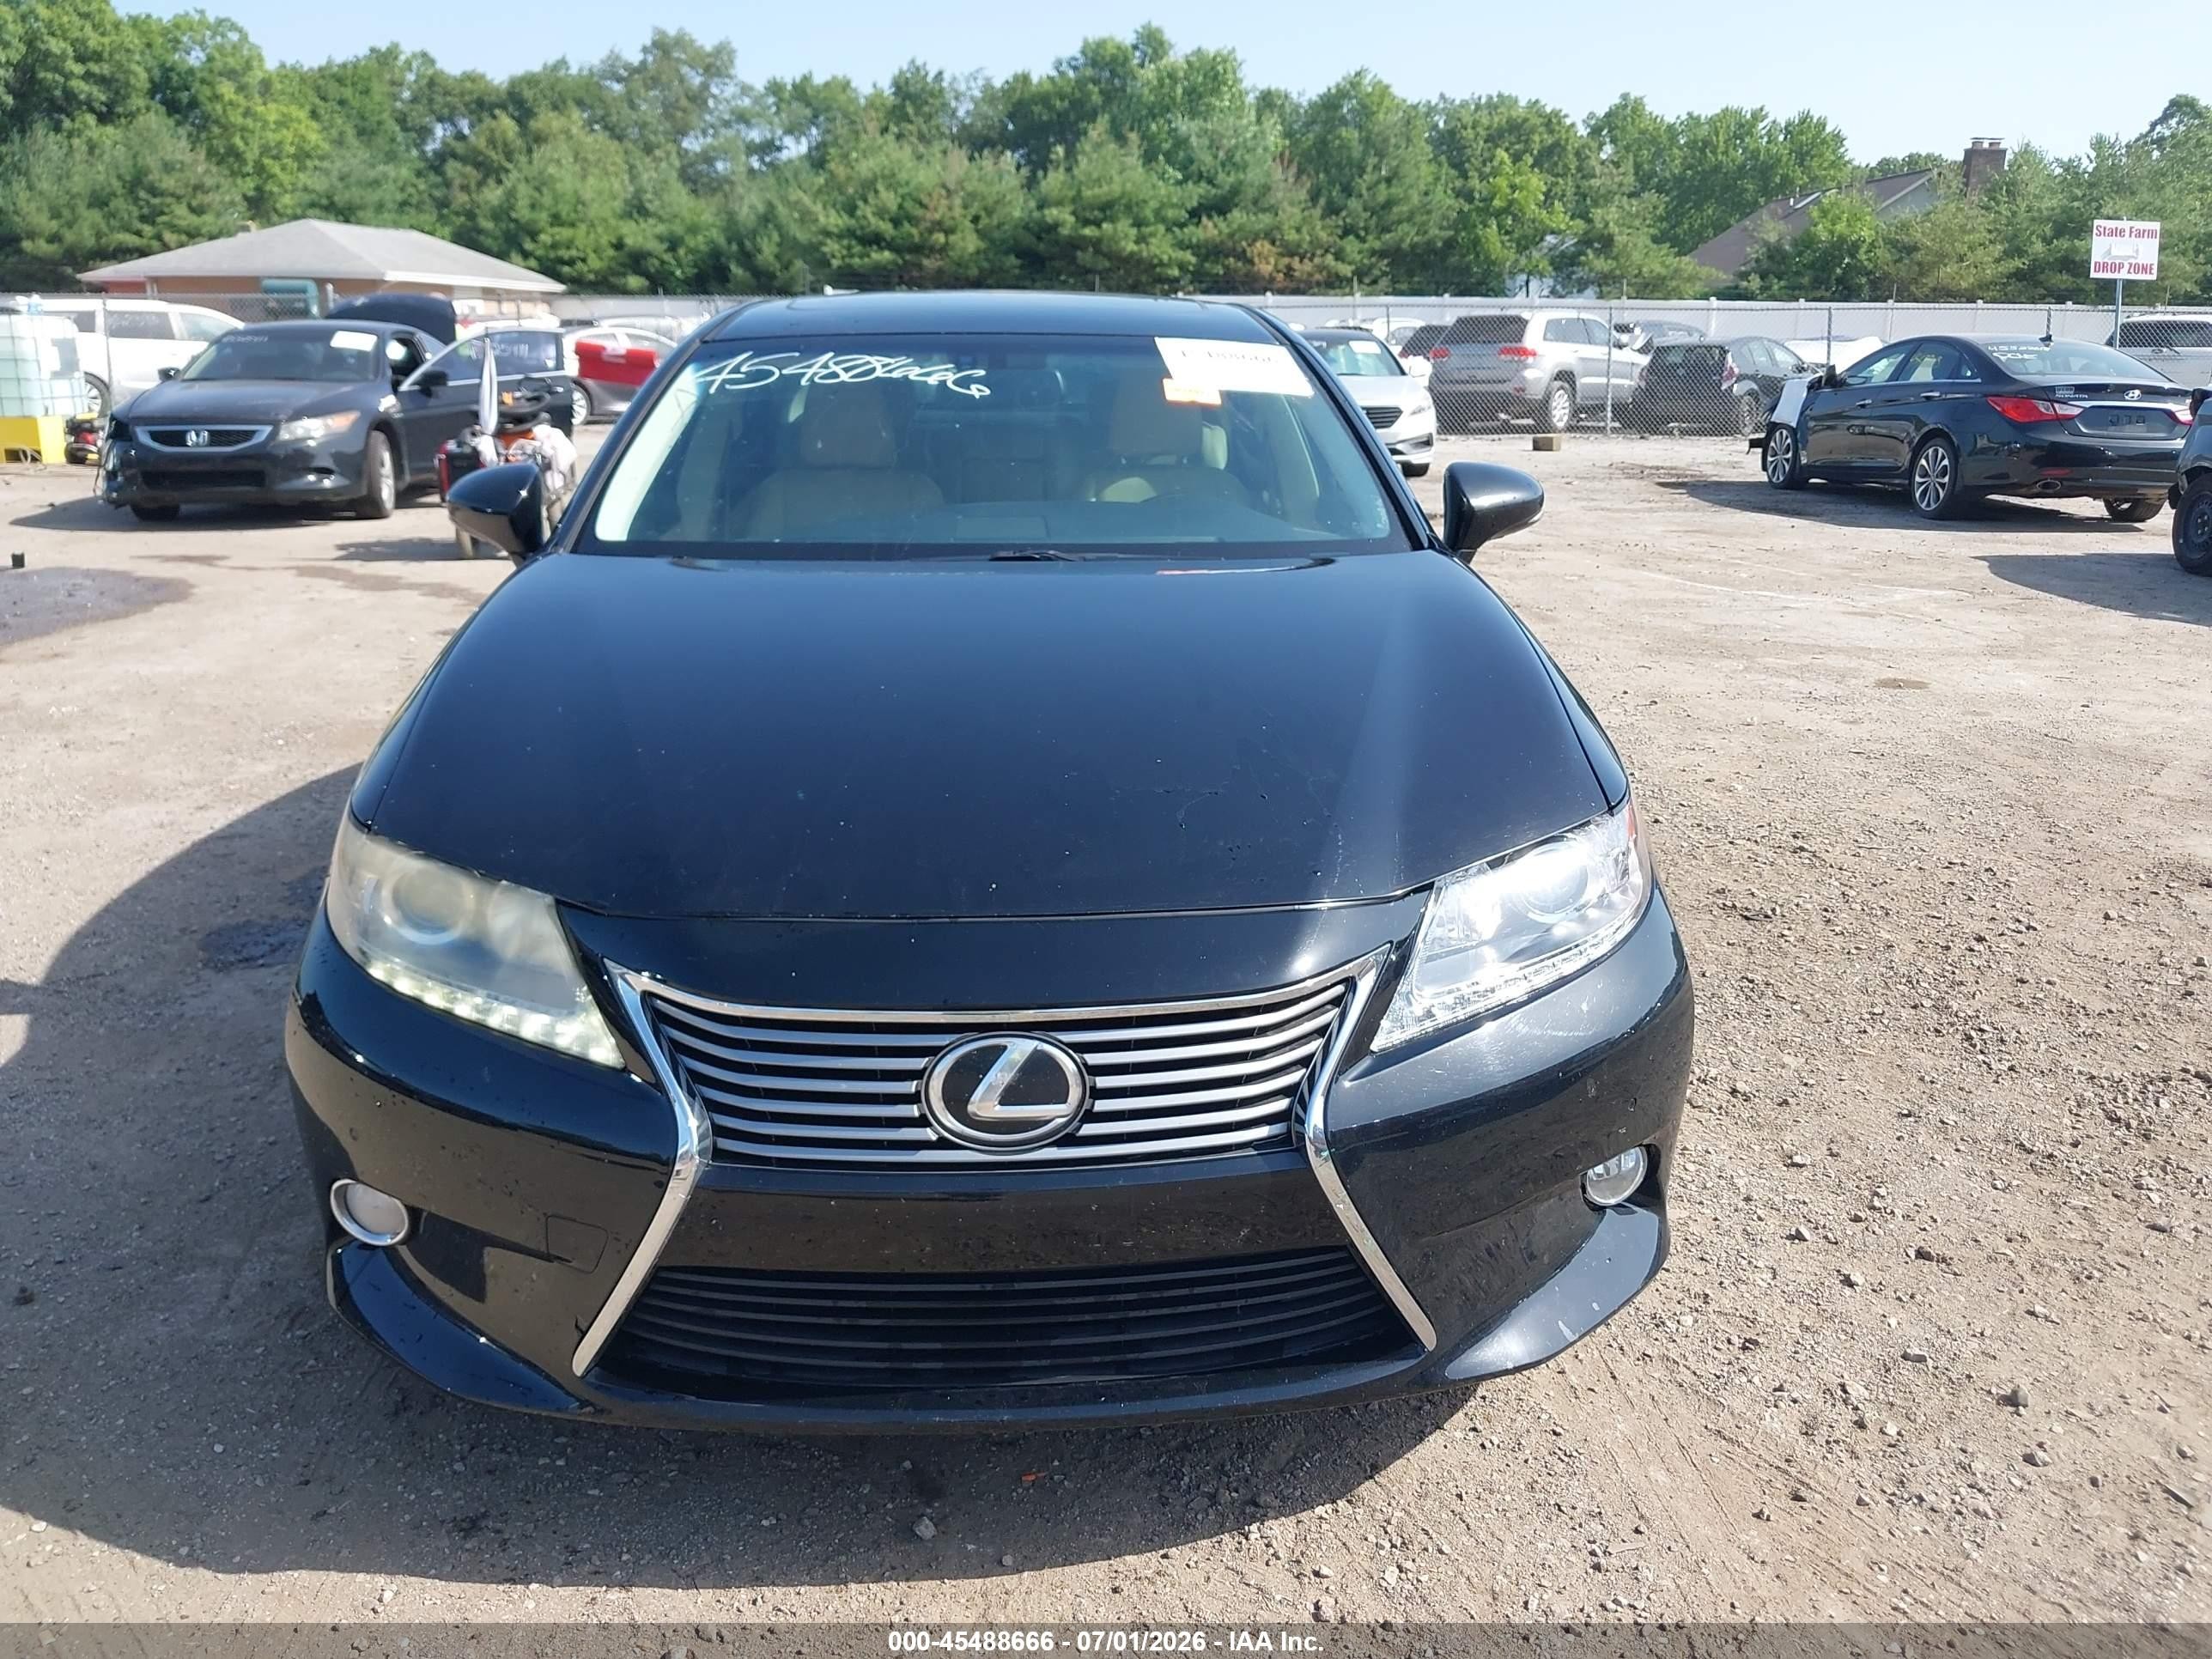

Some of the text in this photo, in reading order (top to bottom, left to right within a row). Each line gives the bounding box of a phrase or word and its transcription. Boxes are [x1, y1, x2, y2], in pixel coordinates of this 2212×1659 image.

[2094, 224, 2158, 240] State Farm
[2094, 261, 2154, 276] DROP ZONE
